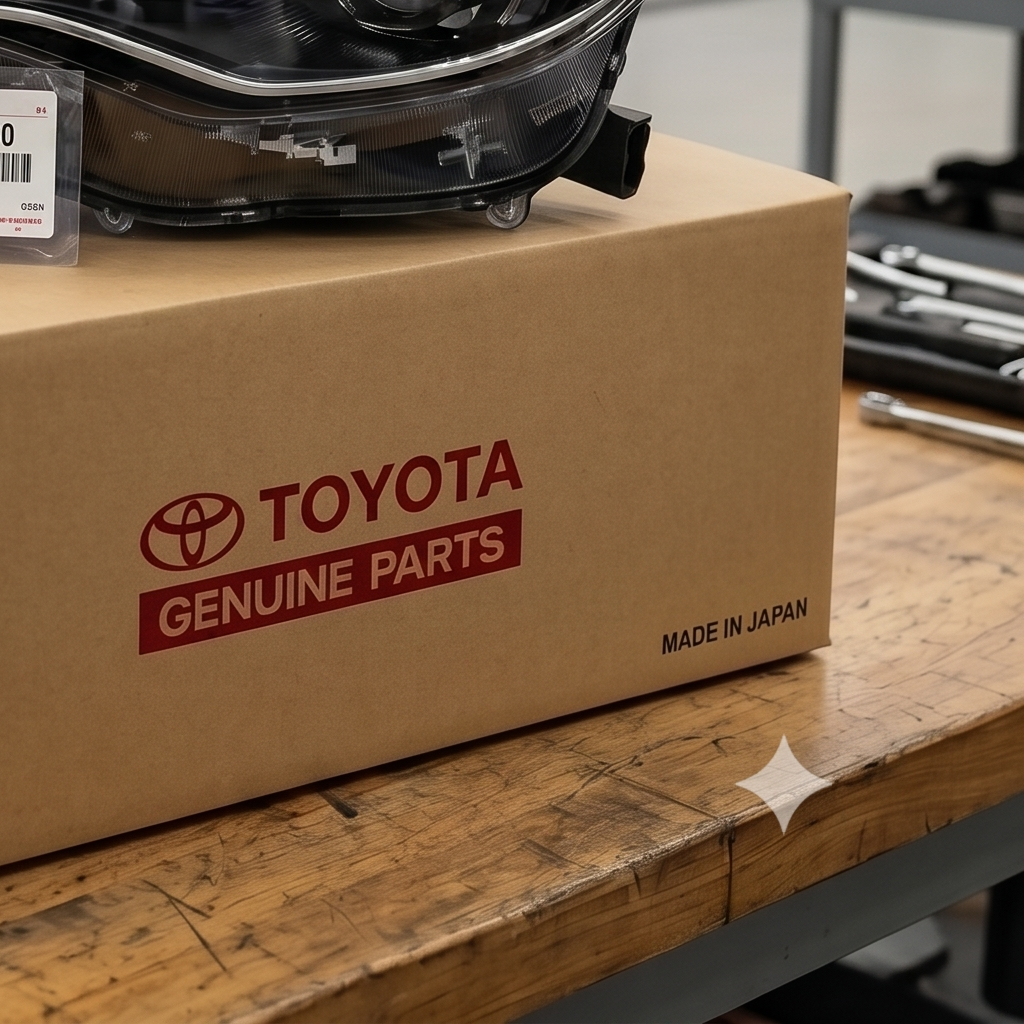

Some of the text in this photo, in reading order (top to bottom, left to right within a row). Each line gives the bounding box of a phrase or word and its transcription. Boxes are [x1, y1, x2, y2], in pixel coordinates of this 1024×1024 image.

[259, 439, 524, 542] TOYOTA
[159, 525, 506, 637] GENUINE PARTS
[662, 597, 807, 655] MADE IN JAPAN
